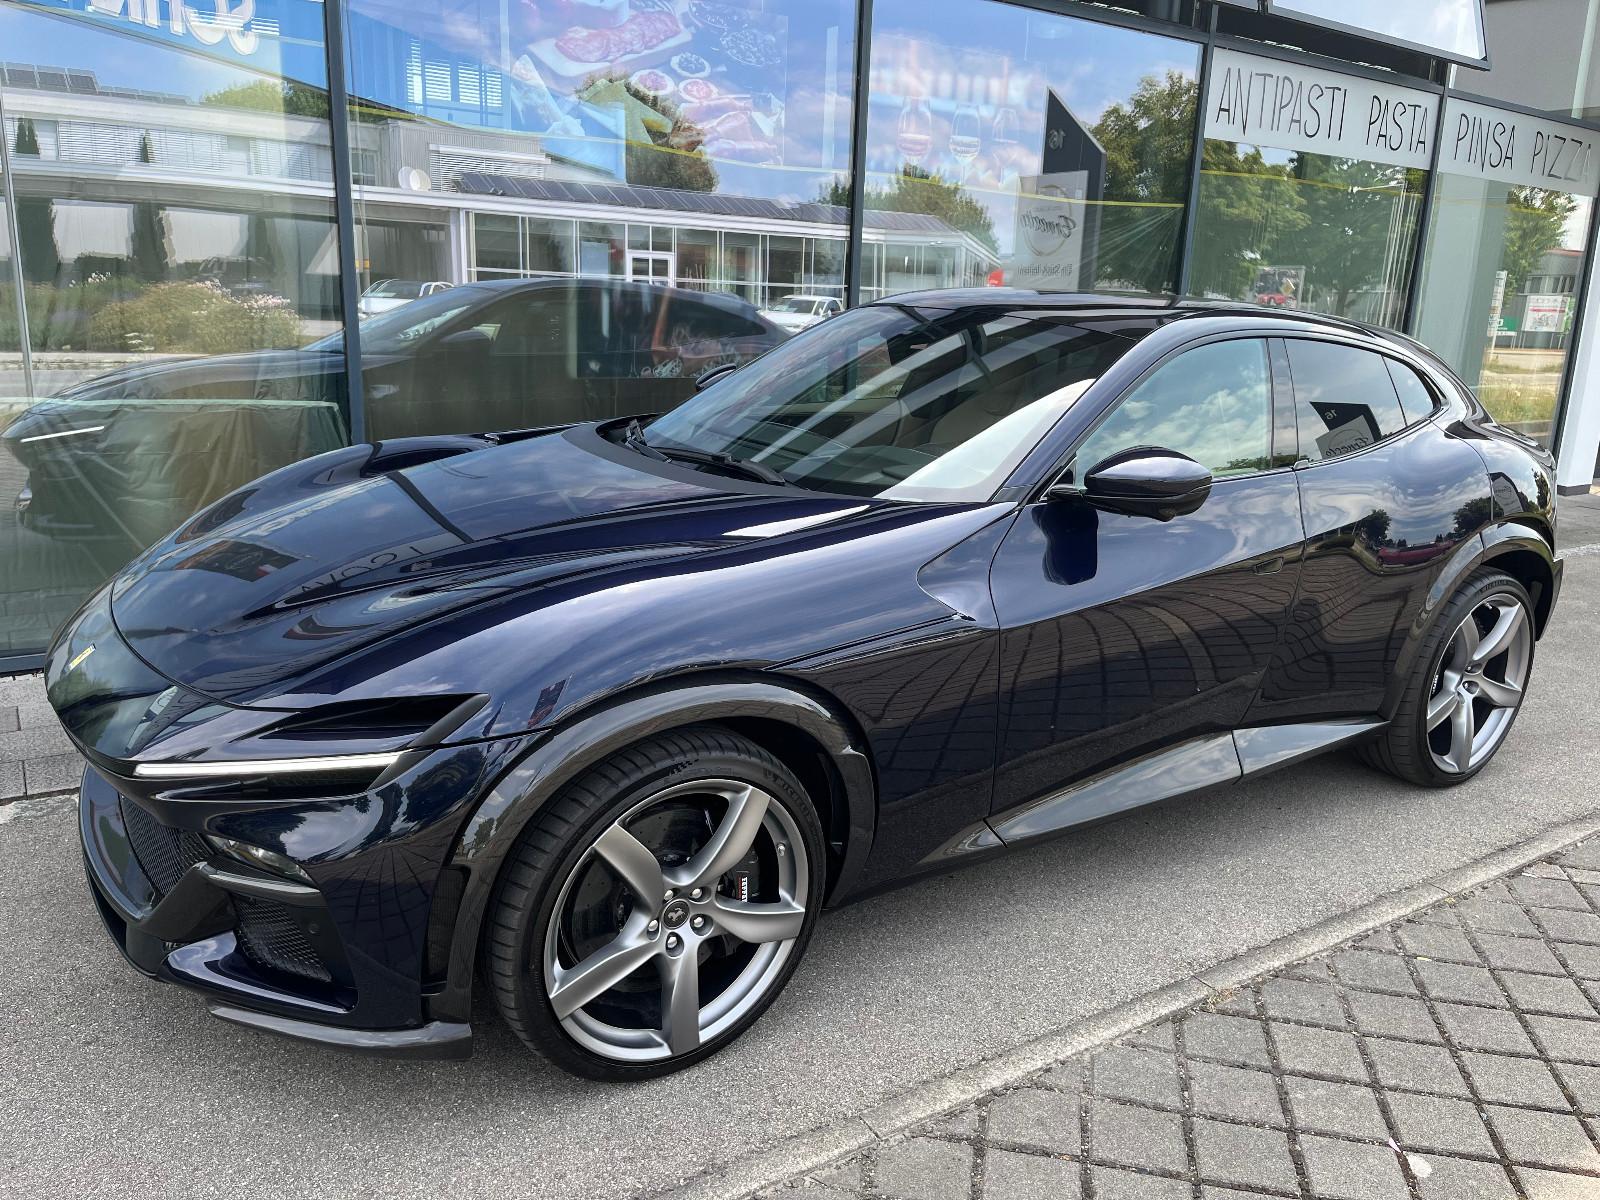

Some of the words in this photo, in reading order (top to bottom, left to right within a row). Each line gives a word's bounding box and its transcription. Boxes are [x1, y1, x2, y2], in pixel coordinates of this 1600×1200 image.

[1216, 67, 1348, 141] ANTIPASTI
[1366, 95, 1429, 155] PASTA
[1454, 113, 1516, 173] PINSA
[1530, 131, 1592, 184] PIZZA
